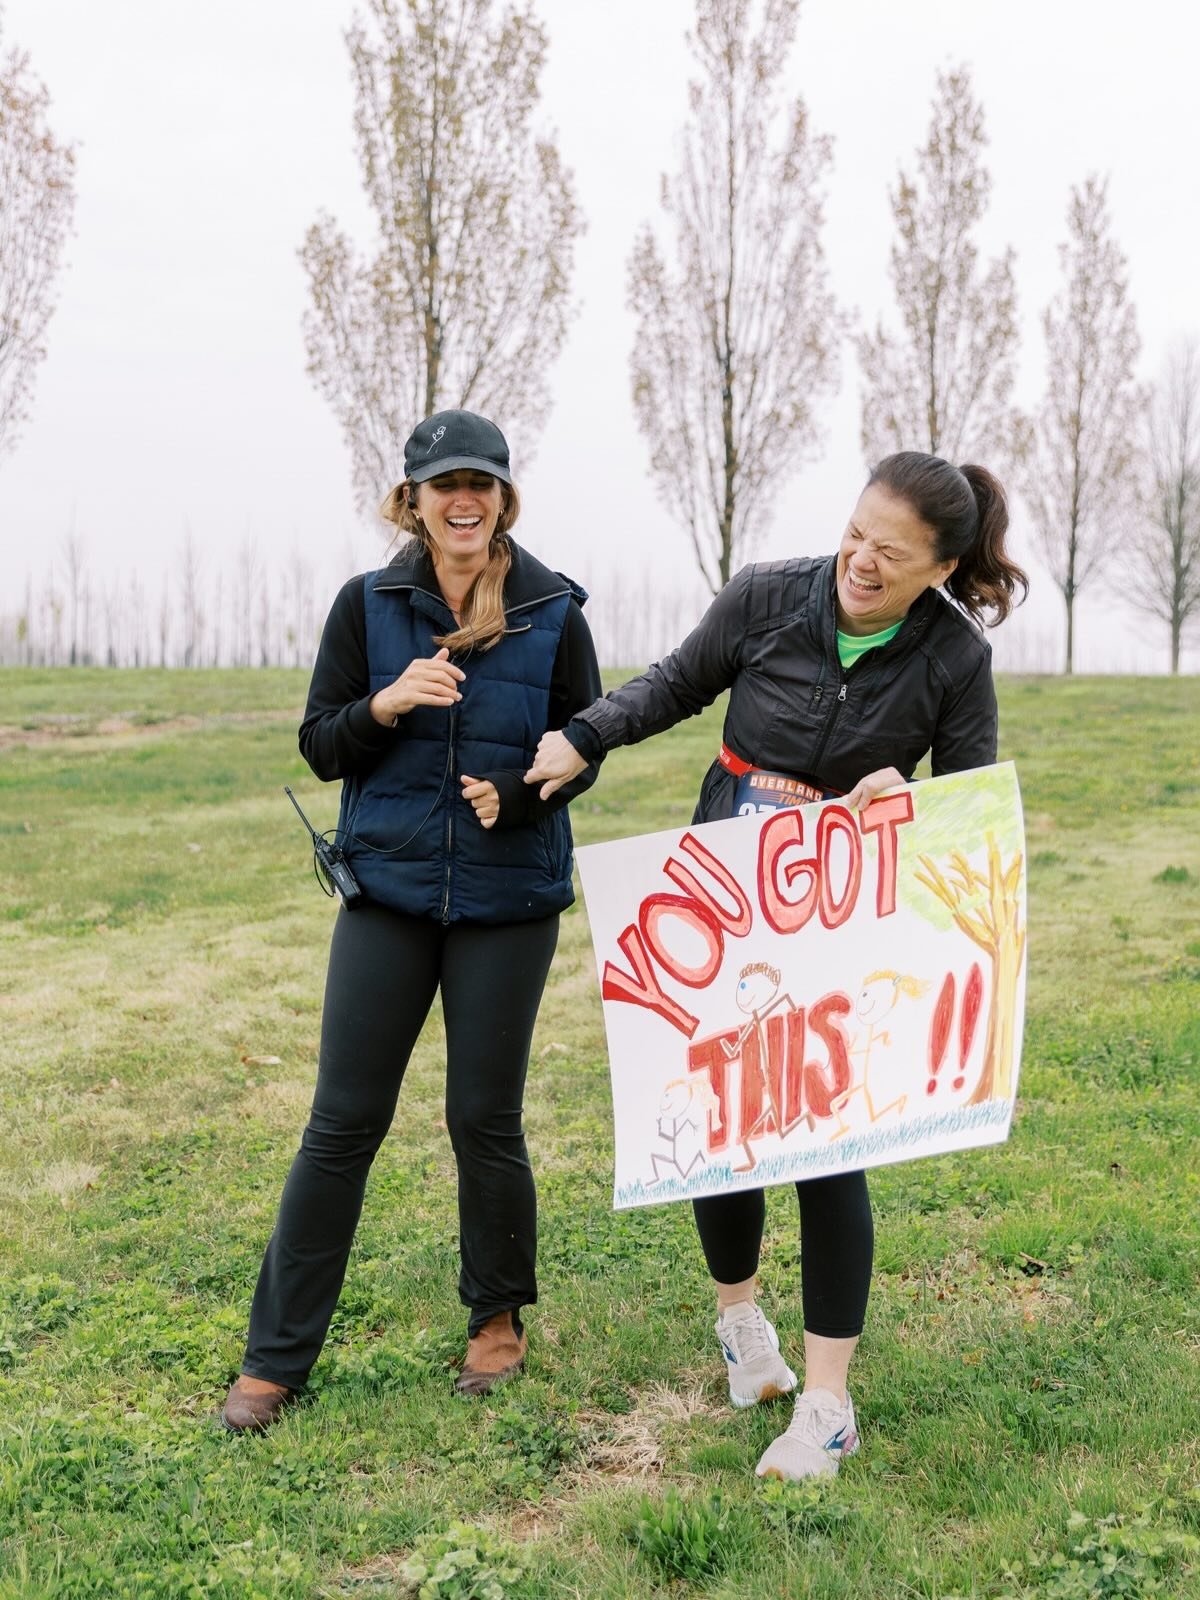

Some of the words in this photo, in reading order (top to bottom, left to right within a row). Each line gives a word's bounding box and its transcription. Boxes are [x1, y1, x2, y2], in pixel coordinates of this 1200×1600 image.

[750, 774, 824, 801] OVERLAND
[778, 793, 810, 806] TIMI
[602, 832, 753, 1040] YOU
[757, 791, 914, 935] GOT
[687, 990, 853, 1154] THIS
